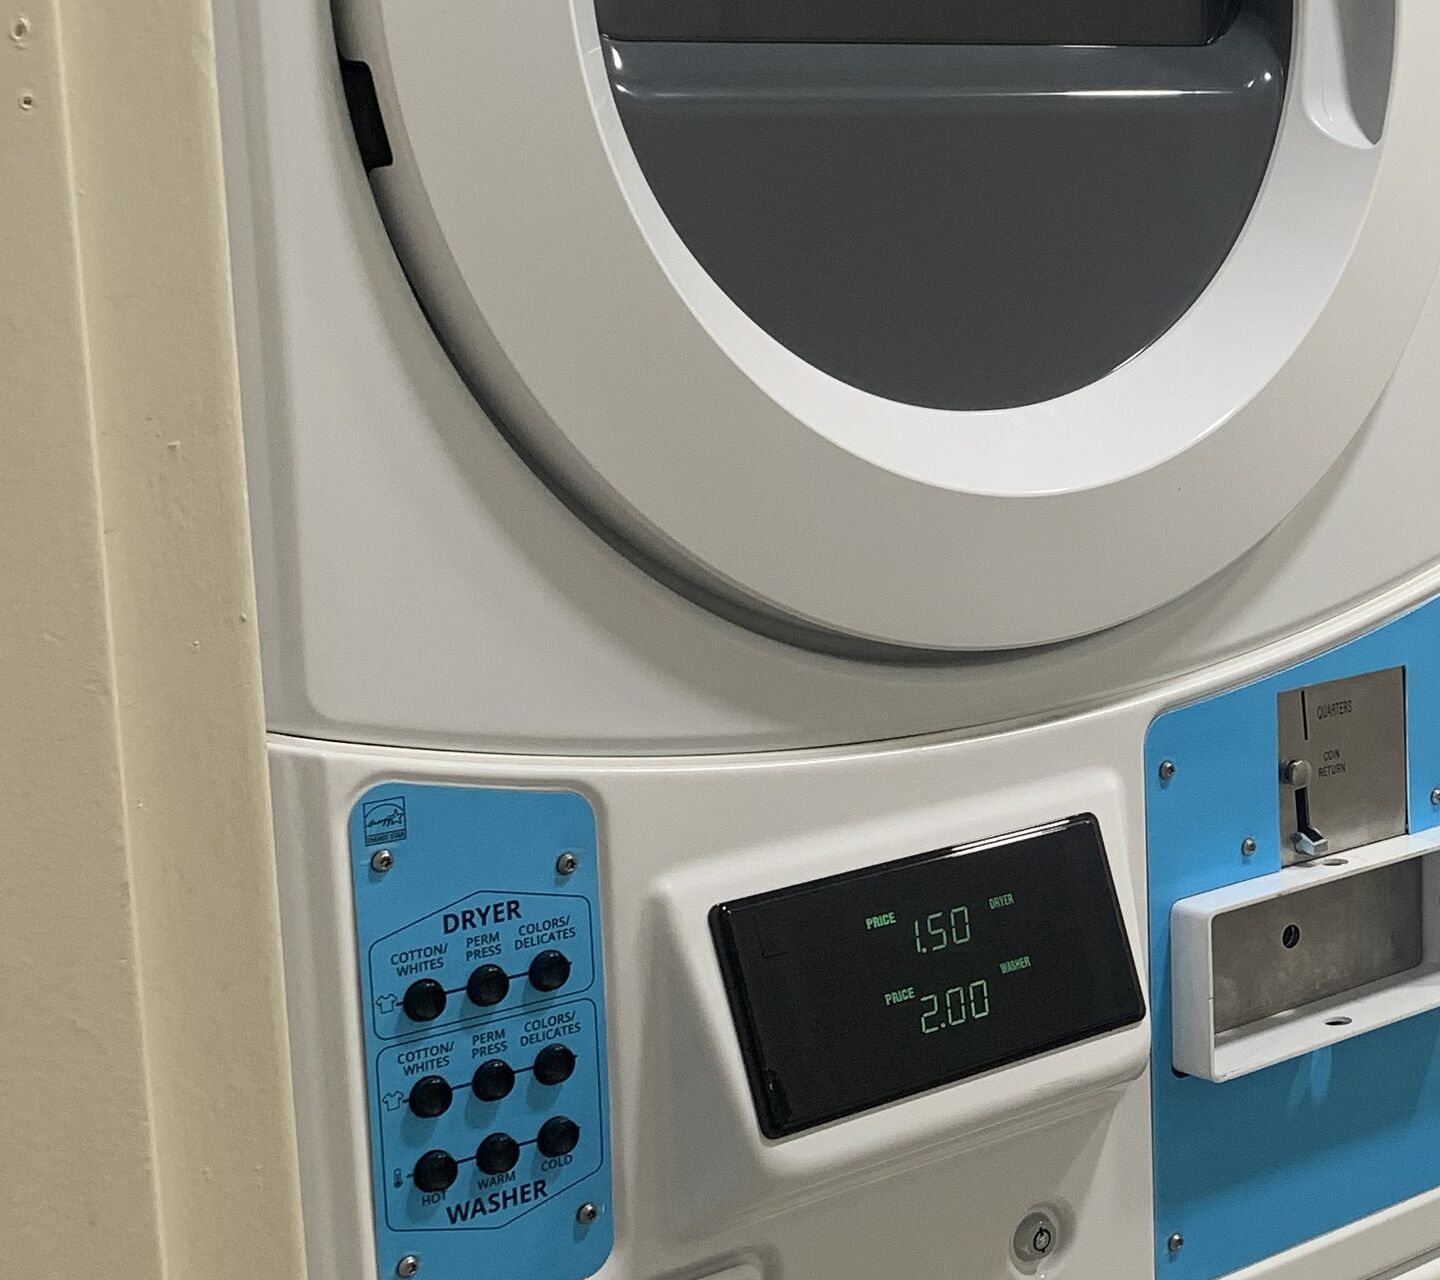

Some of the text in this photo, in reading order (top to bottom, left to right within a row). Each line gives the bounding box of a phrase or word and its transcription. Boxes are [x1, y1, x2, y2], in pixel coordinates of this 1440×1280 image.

[1317, 700, 1353, 720] QUARTERS
[1318, 762, 1346, 778] RETURN
[988, 892, 1014, 911] DRYER
[443, 899, 522, 935] DRYER
[518, 914, 571, 937] COLORS/
[466, 931, 500, 948] PERM
[515, 926, 576, 950] DELICATES
[866, 905, 972, 955] PRICE 1.50
[391, 943, 448, 966] COTTON/
[466, 943, 502, 962] PRESS
[396, 957, 444, 978] WHITES
[1000, 955, 1032, 975] WASHER
[884, 979, 992, 1034] PRICE 2.00
[523, 1010, 576, 1033] COLORS/
[472, 1028, 506, 1046] PERM
[520, 1022, 581, 1047] DELICATES
[397, 1041, 454, 1065] COTTON/
[471, 1041, 508, 1059] PRESS
[403, 1055, 450, 1076] WHITES
[541, 1154, 573, 1172] COLD
[477, 1171, 516, 1190] WARM
[421, 1191, 447, 1207] HOT
[446, 1179, 549, 1225] WASHER
